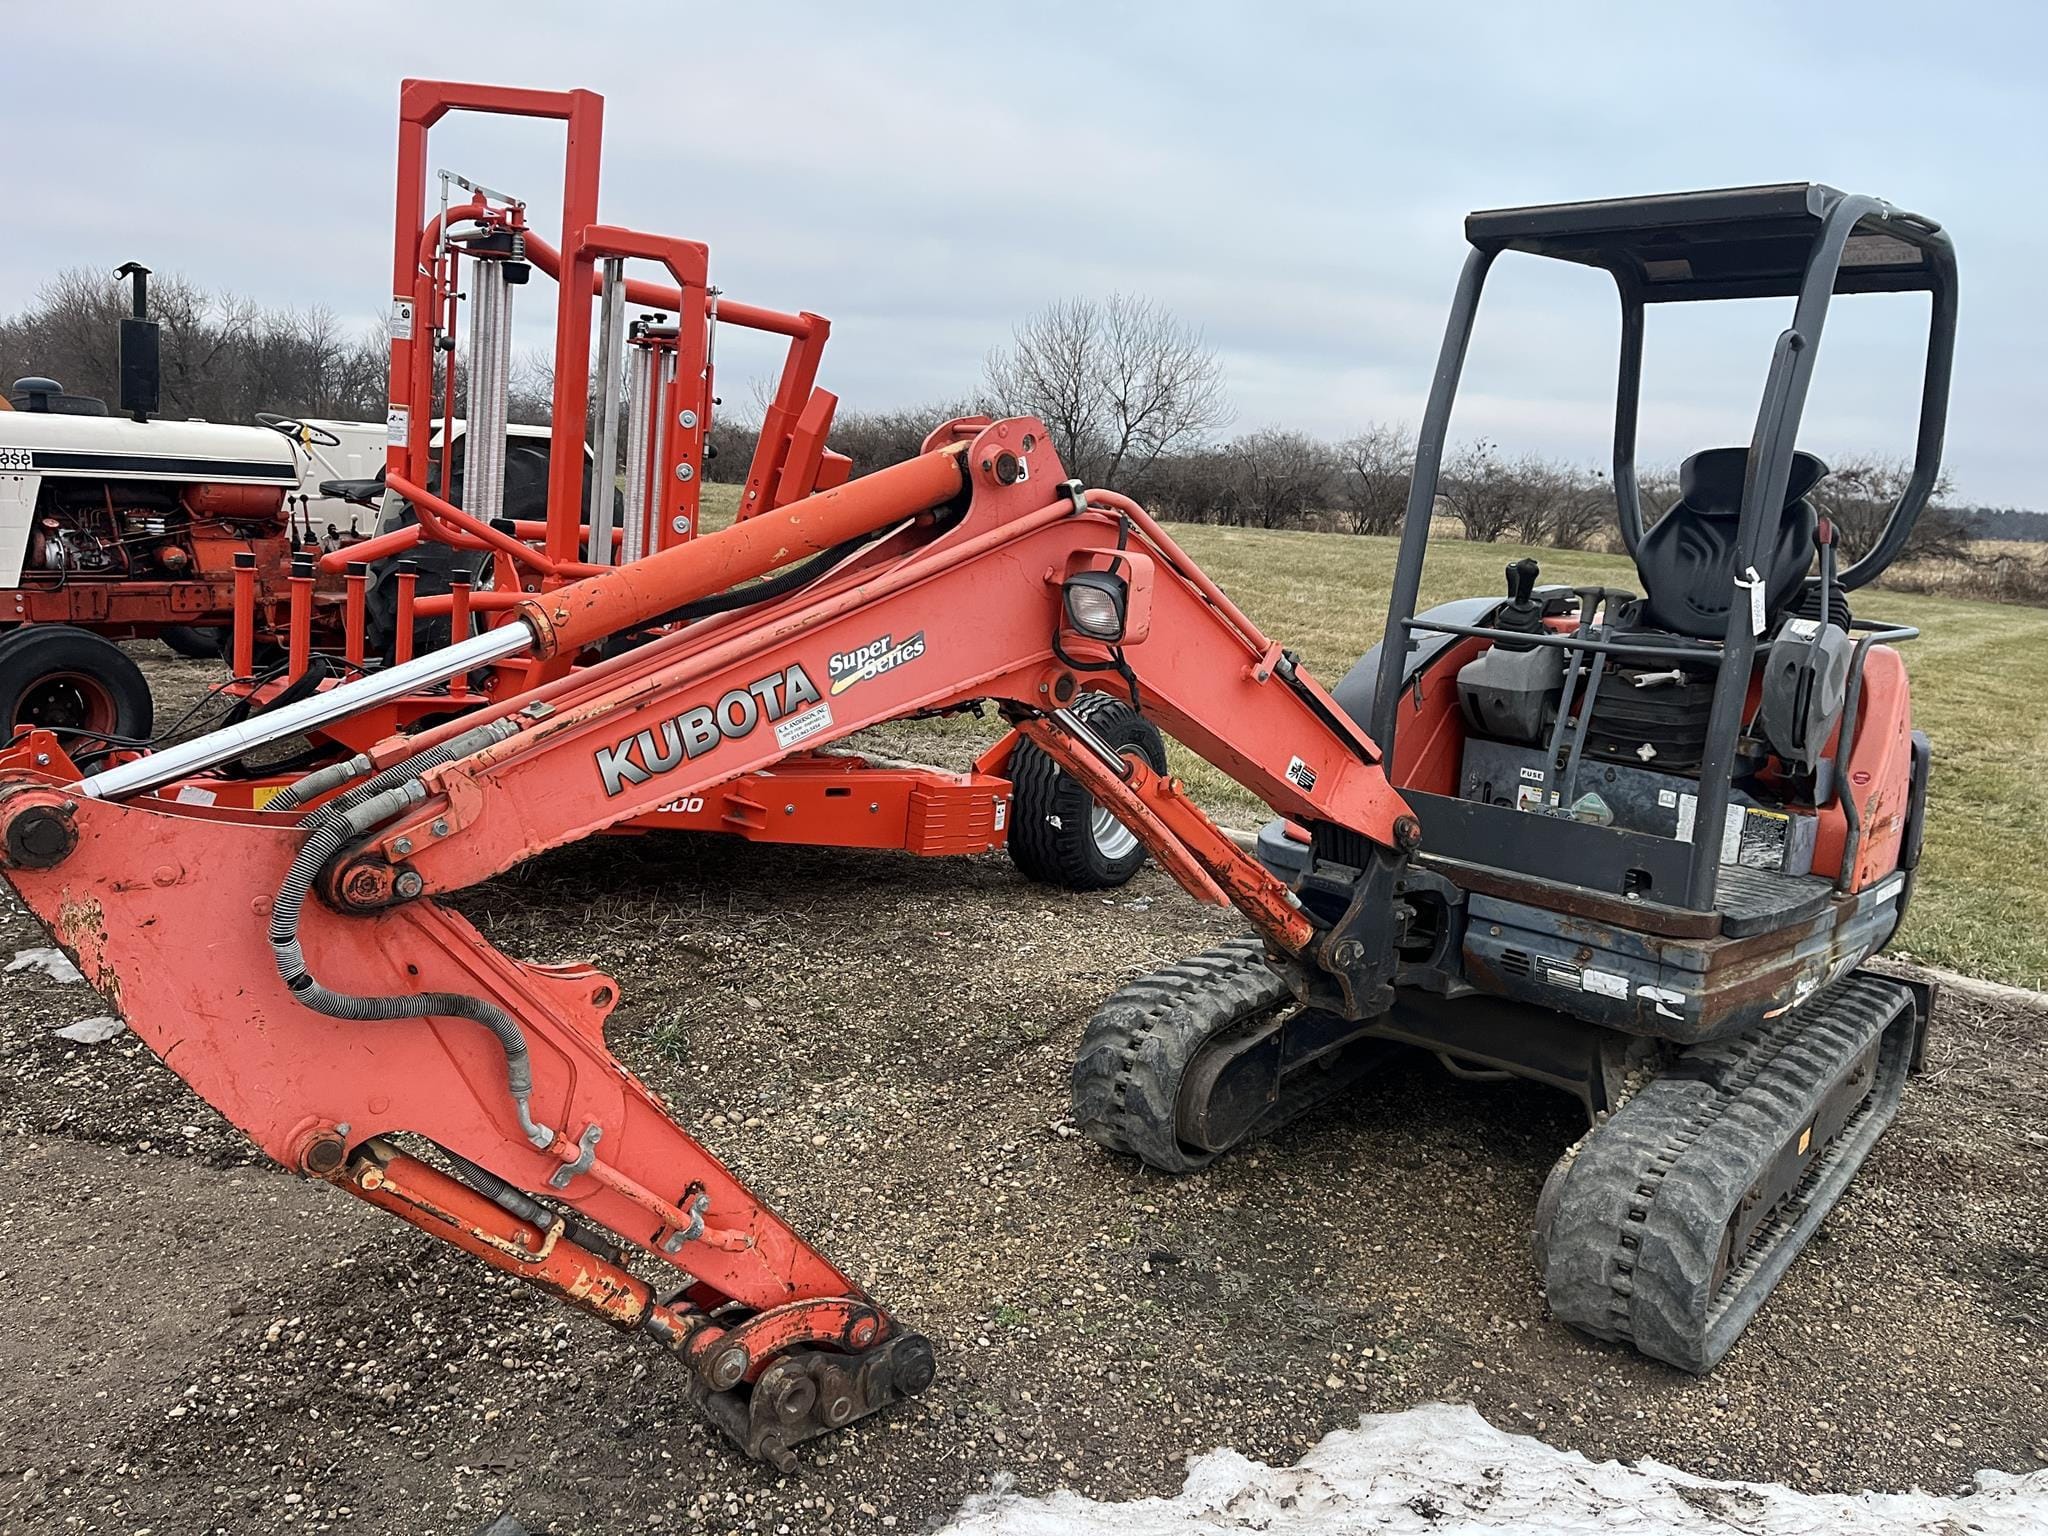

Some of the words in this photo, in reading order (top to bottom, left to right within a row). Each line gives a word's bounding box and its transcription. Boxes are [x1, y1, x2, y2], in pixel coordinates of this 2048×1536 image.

[829, 636, 890, 677] Super
[863, 639, 925, 680] Series
[595, 663, 821, 796] KUBOTA
[1521, 769, 1542, 780] FUSE
